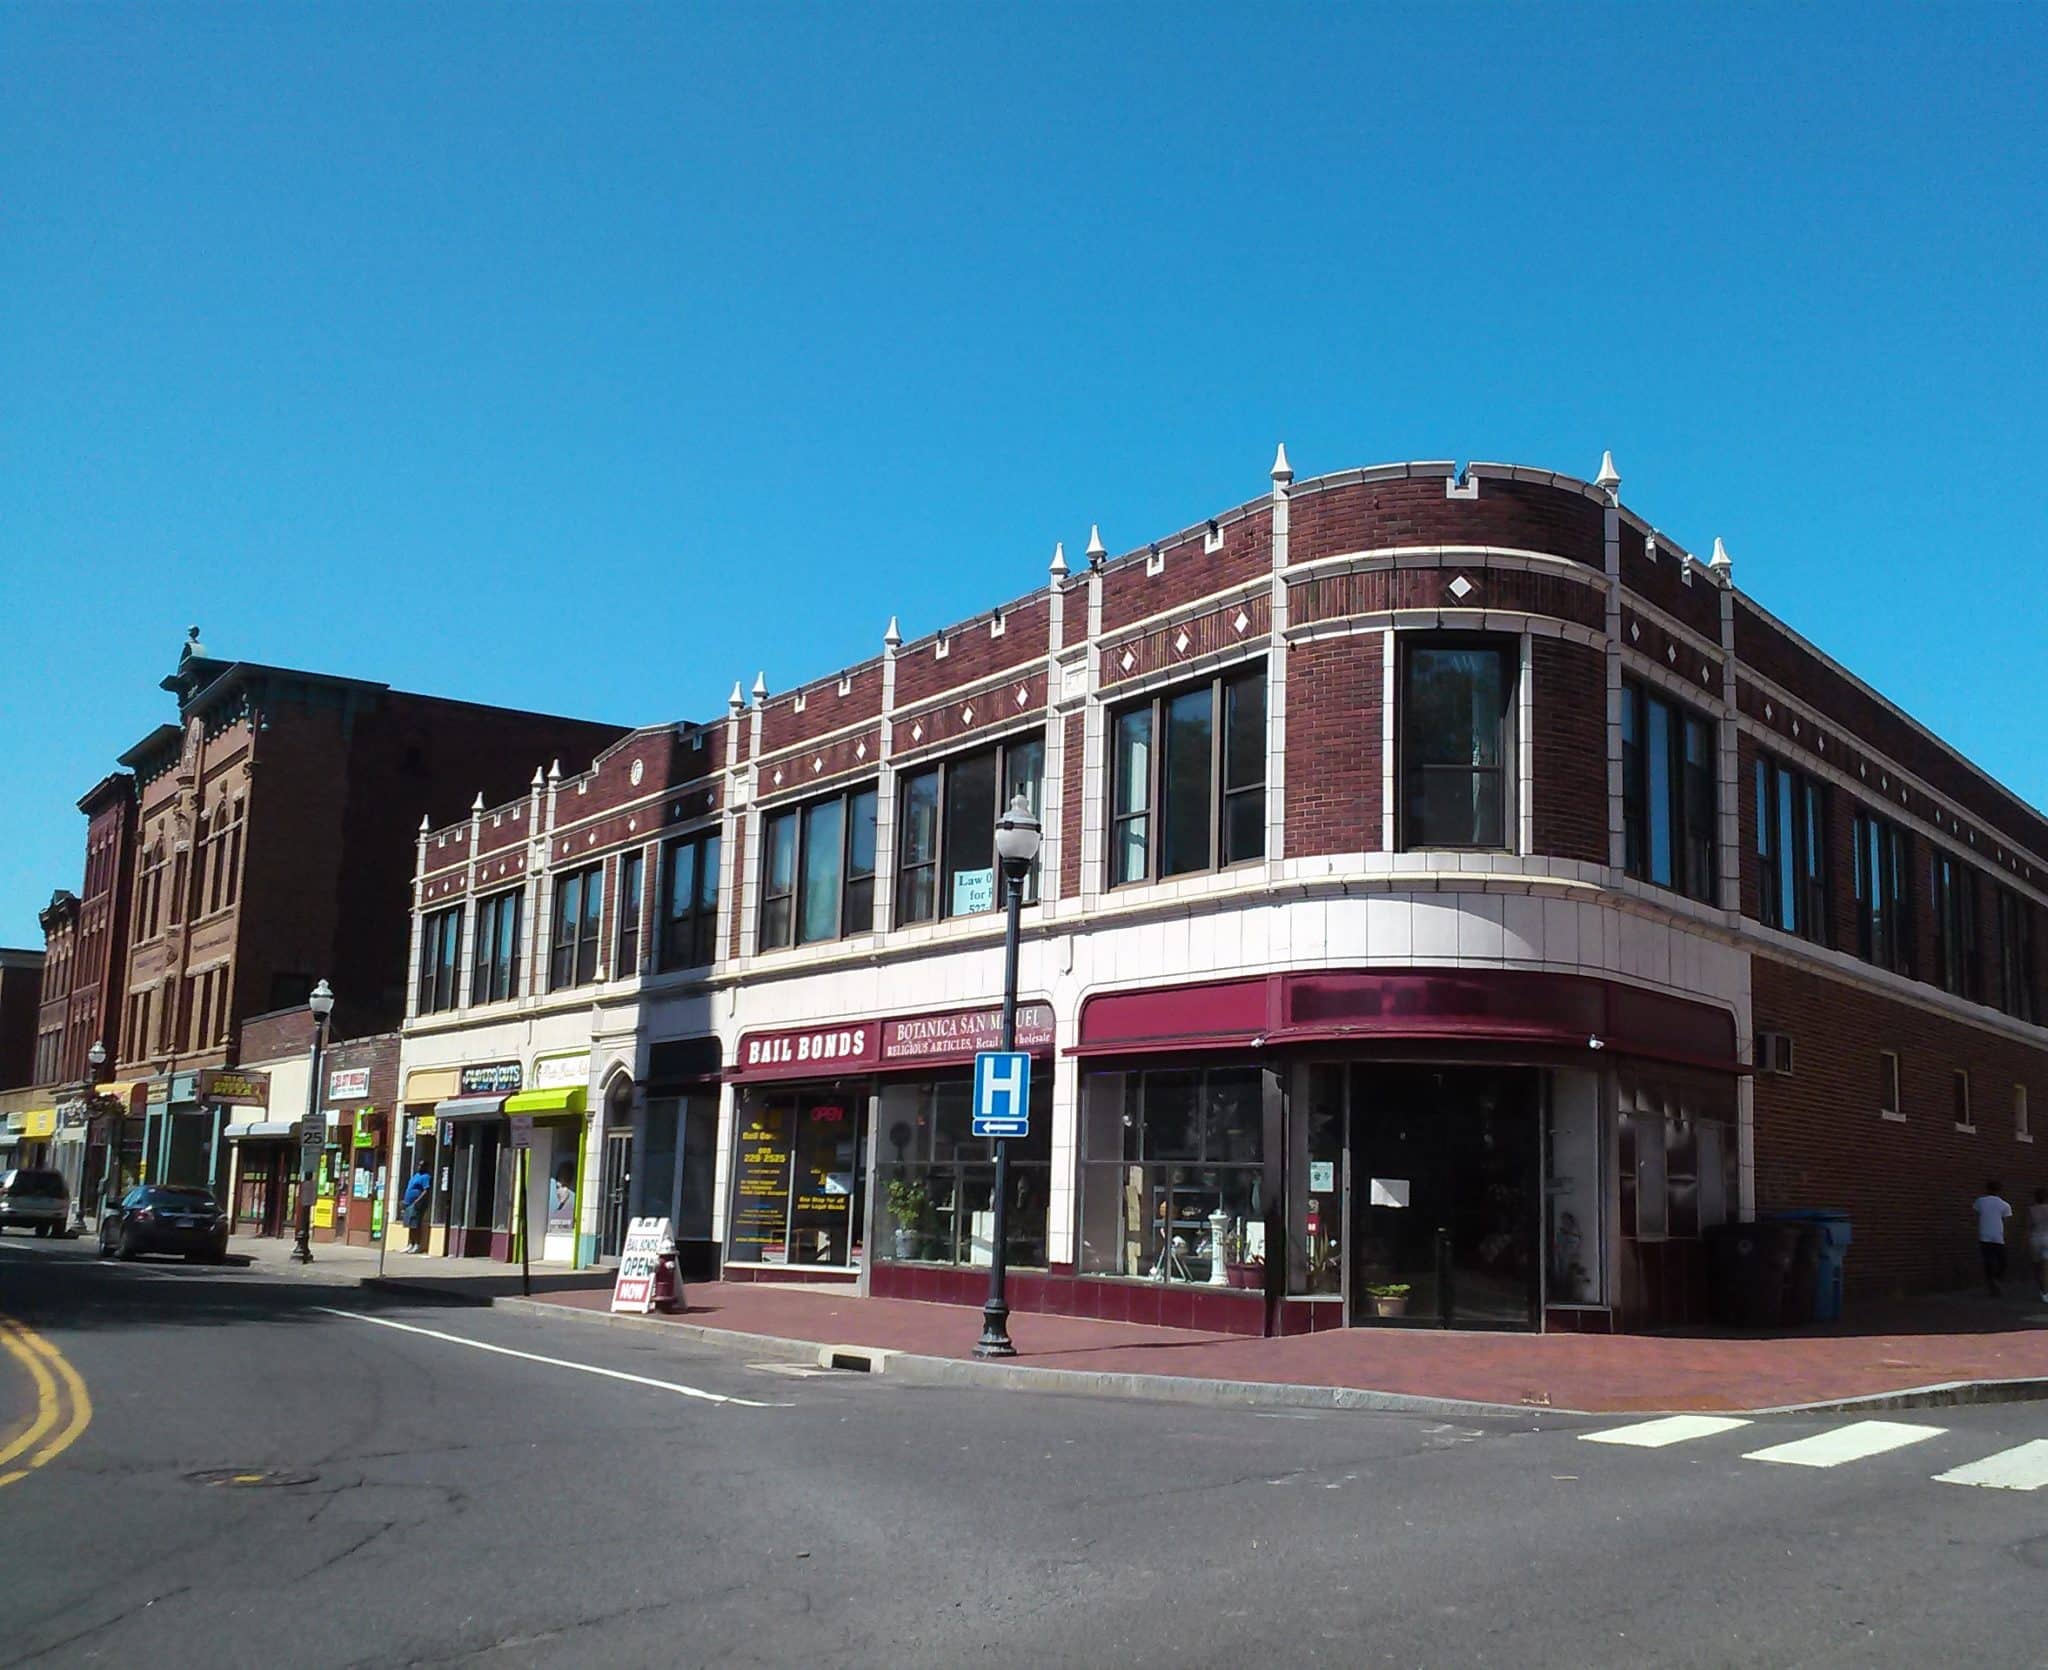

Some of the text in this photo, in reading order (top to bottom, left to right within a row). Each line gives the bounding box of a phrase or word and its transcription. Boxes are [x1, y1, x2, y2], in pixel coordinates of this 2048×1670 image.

[959, 874, 983, 887] Law
[969, 889, 985, 901] for
[897, 1019, 957, 1041] BOTANICA
[960, 1015, 985, 1034] SAN
[748, 1030, 865, 1064] BAIL BONDS
[887, 1041, 928, 1057] RELIGIOUS
[976, 1036, 999, 1049] Retail
[1015, 1032, 1051, 1045] holesale
[499, 1065, 520, 1083] CUTS
[982, 1056, 1021, 1115] H
[811, 1106, 843, 1121] OPEN
[303, 1131, 322, 1145] 25
[623, 1256, 651, 1277] OPEN
[620, 1282, 647, 1300] NOW
